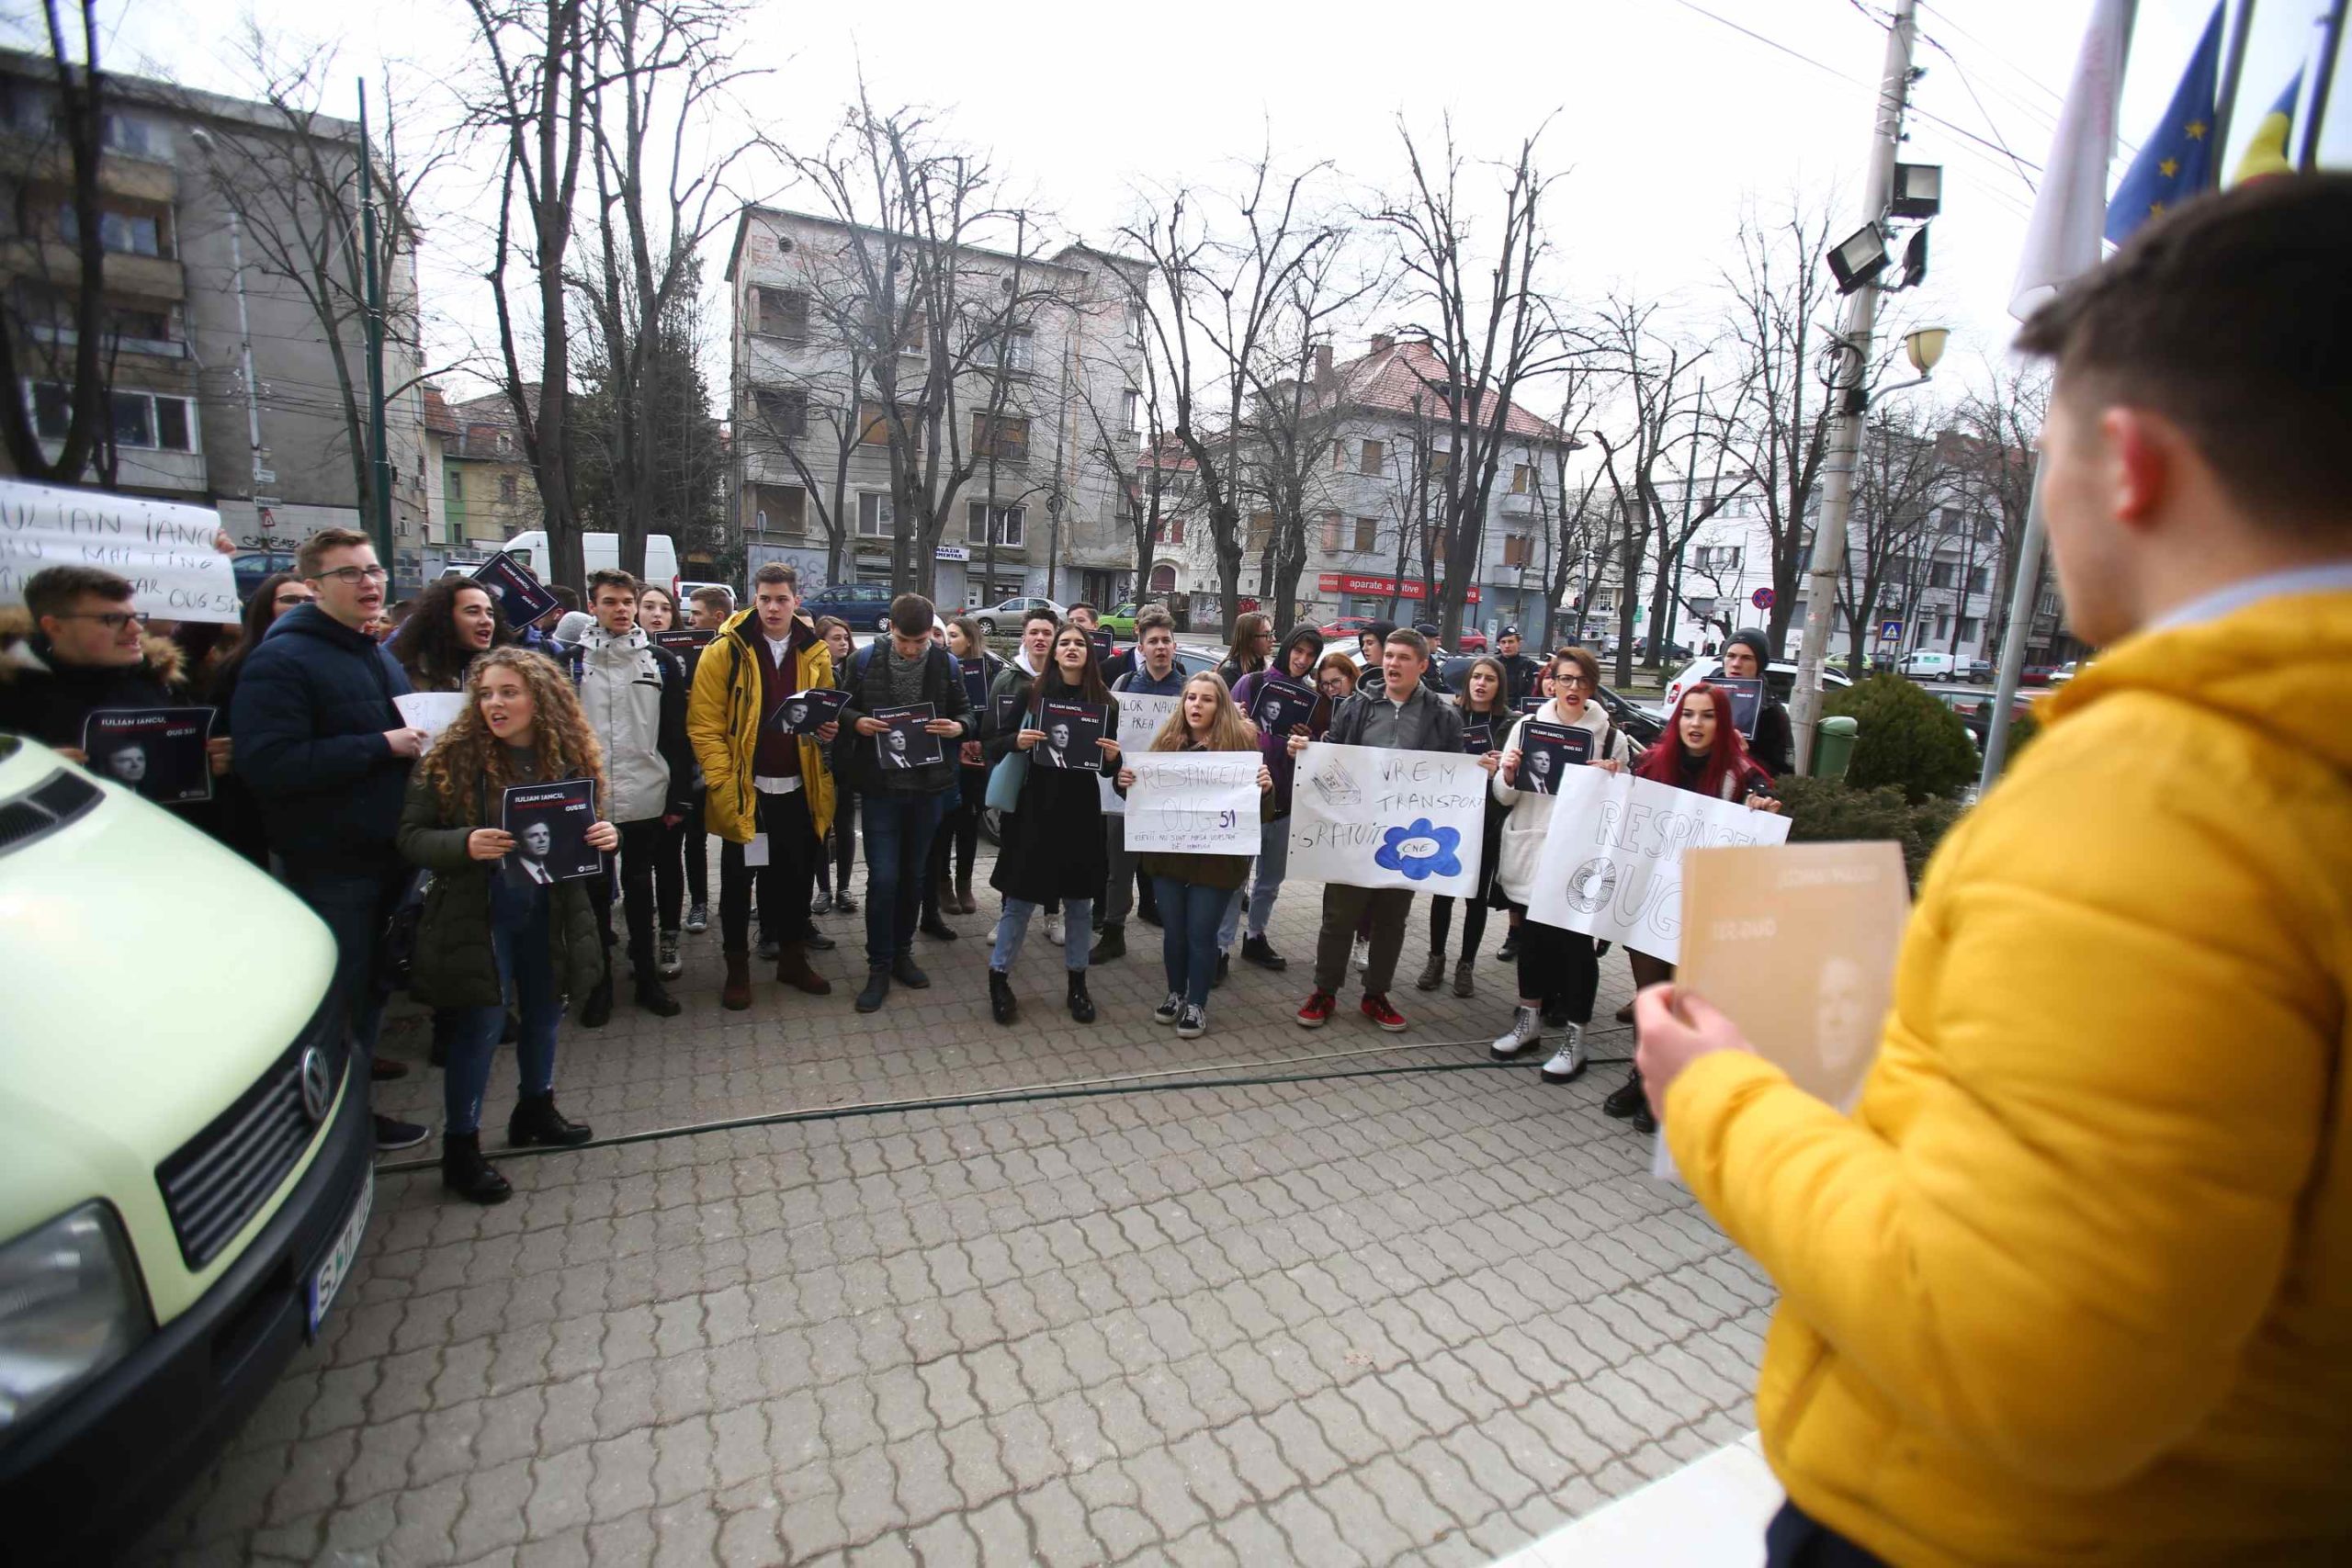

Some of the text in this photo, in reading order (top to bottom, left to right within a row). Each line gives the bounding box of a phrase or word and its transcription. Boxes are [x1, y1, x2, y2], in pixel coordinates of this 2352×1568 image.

[1, 499, 121, 534] ULIAN
[1350, 580, 1383, 590] aparate
[1385, 584, 1419, 593] auitive
[169, 588, 209, 609] OUG
[1119, 701, 1143, 712] ILOR
[1132, 719, 1154, 730] PREA
[1376, 793, 1487, 812] TRANSPORT
[1219, 809, 1236, 828] 51
[1297, 822, 1387, 849] GRATUIT
[1402, 842, 1432, 853] CNE
[1566, 856, 1683, 941] OUG
